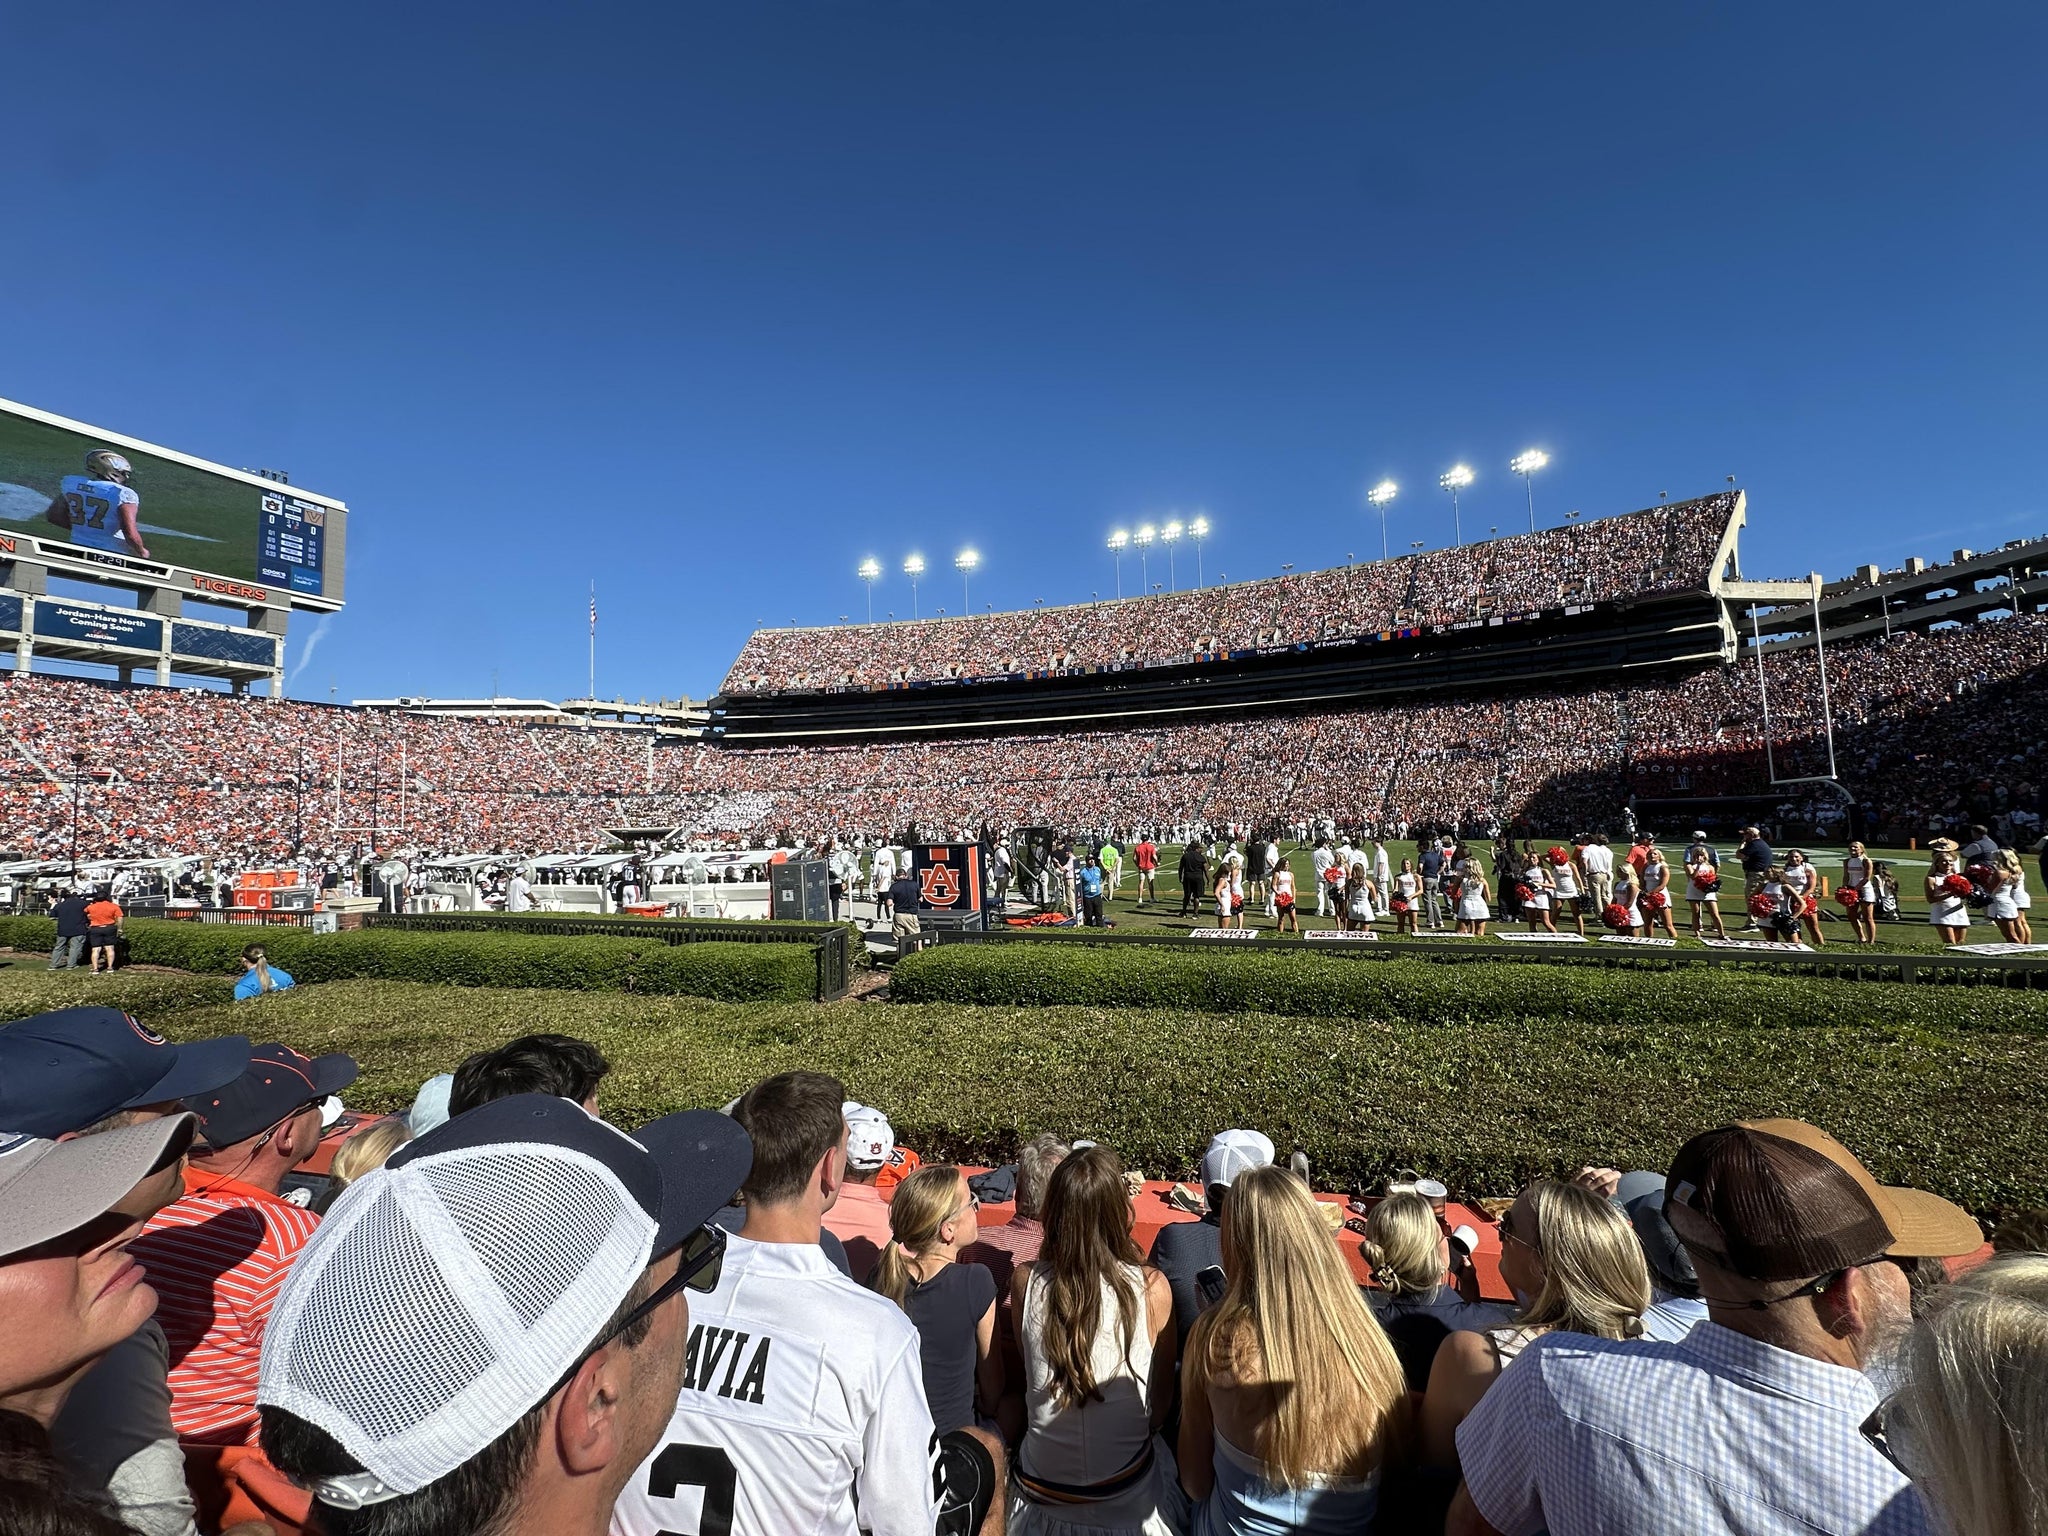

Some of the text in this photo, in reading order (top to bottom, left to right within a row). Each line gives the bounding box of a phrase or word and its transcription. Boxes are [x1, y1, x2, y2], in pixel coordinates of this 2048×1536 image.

[66, 492, 109, 529] 37
[269, 514, 275, 524] 0
[310, 526, 316, 536] 0
[0, 537, 16, 552] N
[192, 576, 266, 600] TIGERS
[56, 608, 146, 627] Jordan-Hare North
[70, 618, 108, 630] Coming
[110, 624, 133, 632] Soon
[1453, 622, 1469, 630] TEXAS
[1322, 639, 1358, 647] Everything.
[237, 893, 267, 907] G G
[1607, 936, 1668, 944] DEFENSE
[684, 1324, 771, 1404] AVIA
